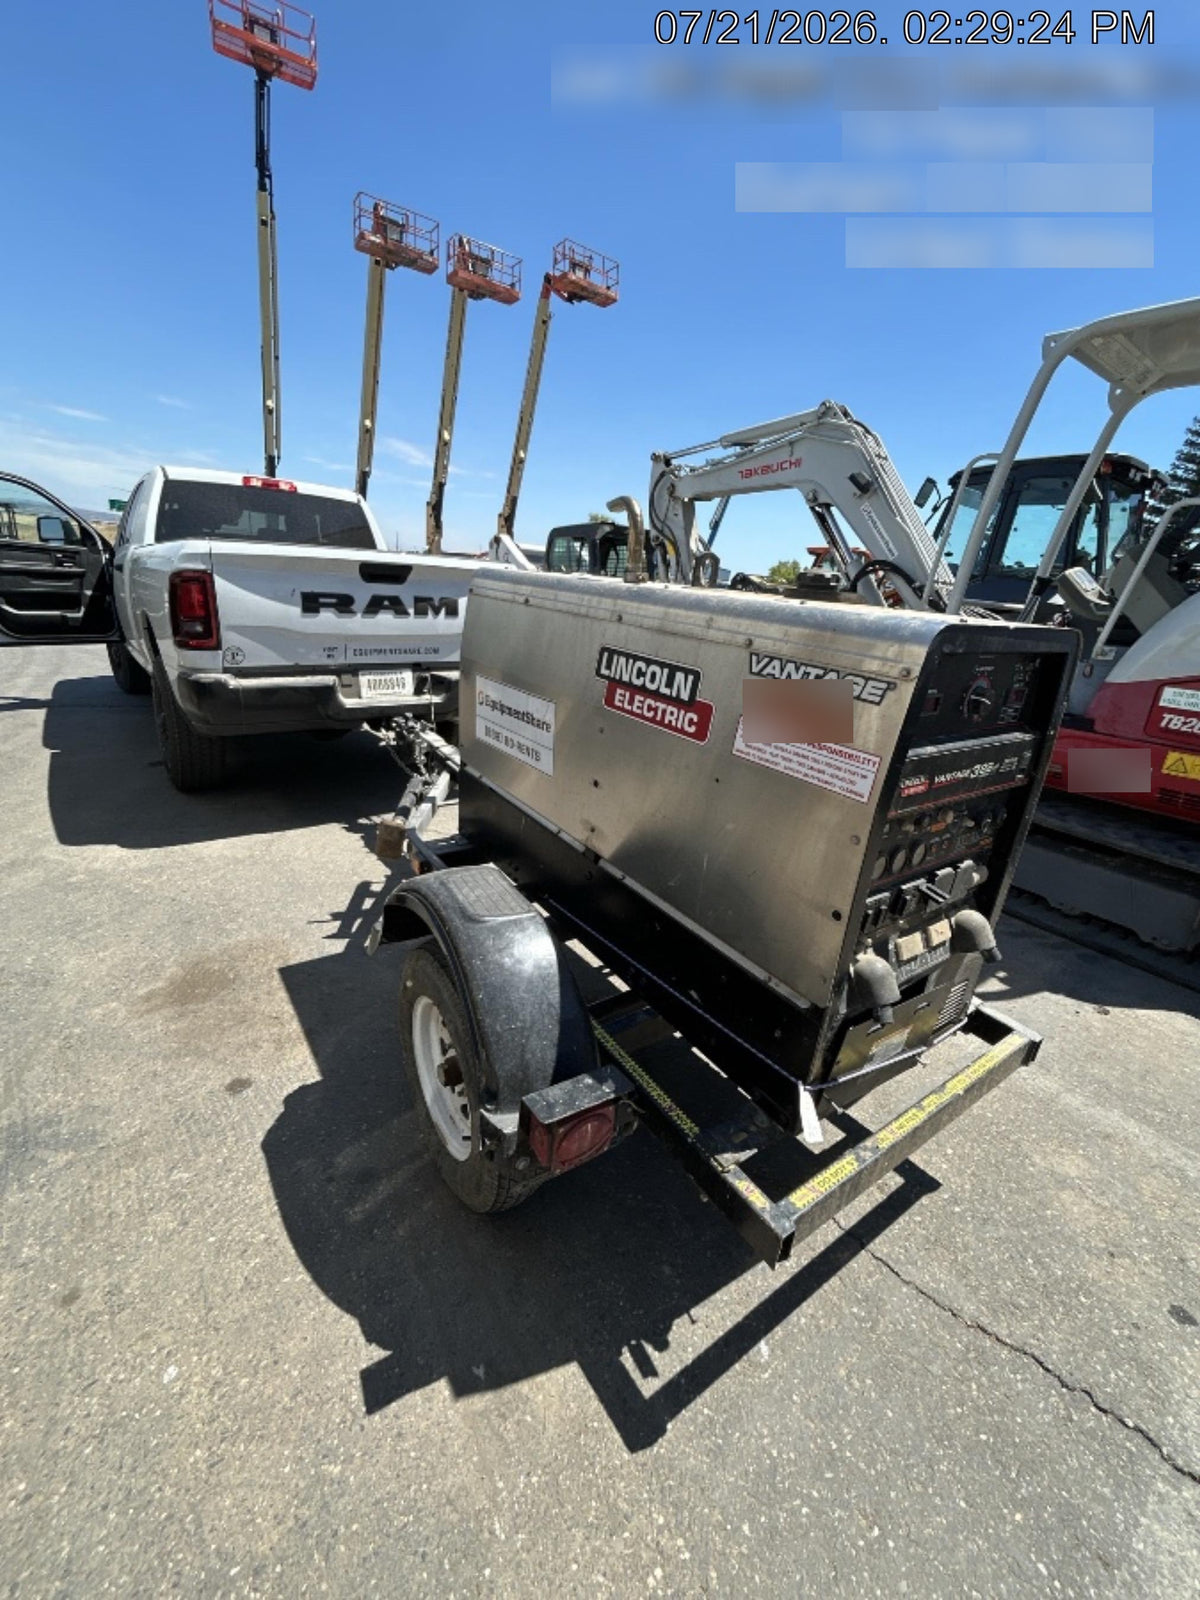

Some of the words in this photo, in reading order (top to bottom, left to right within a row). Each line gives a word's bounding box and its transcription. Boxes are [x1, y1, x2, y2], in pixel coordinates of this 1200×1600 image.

[738, 457, 803, 480] TAKEUCHI
[300, 591, 459, 619] RAM
[600, 651, 695, 702] LINCOLN
[485, 694, 552, 733] EquipmentShare
[614, 687, 698, 734] ELECTRIC
